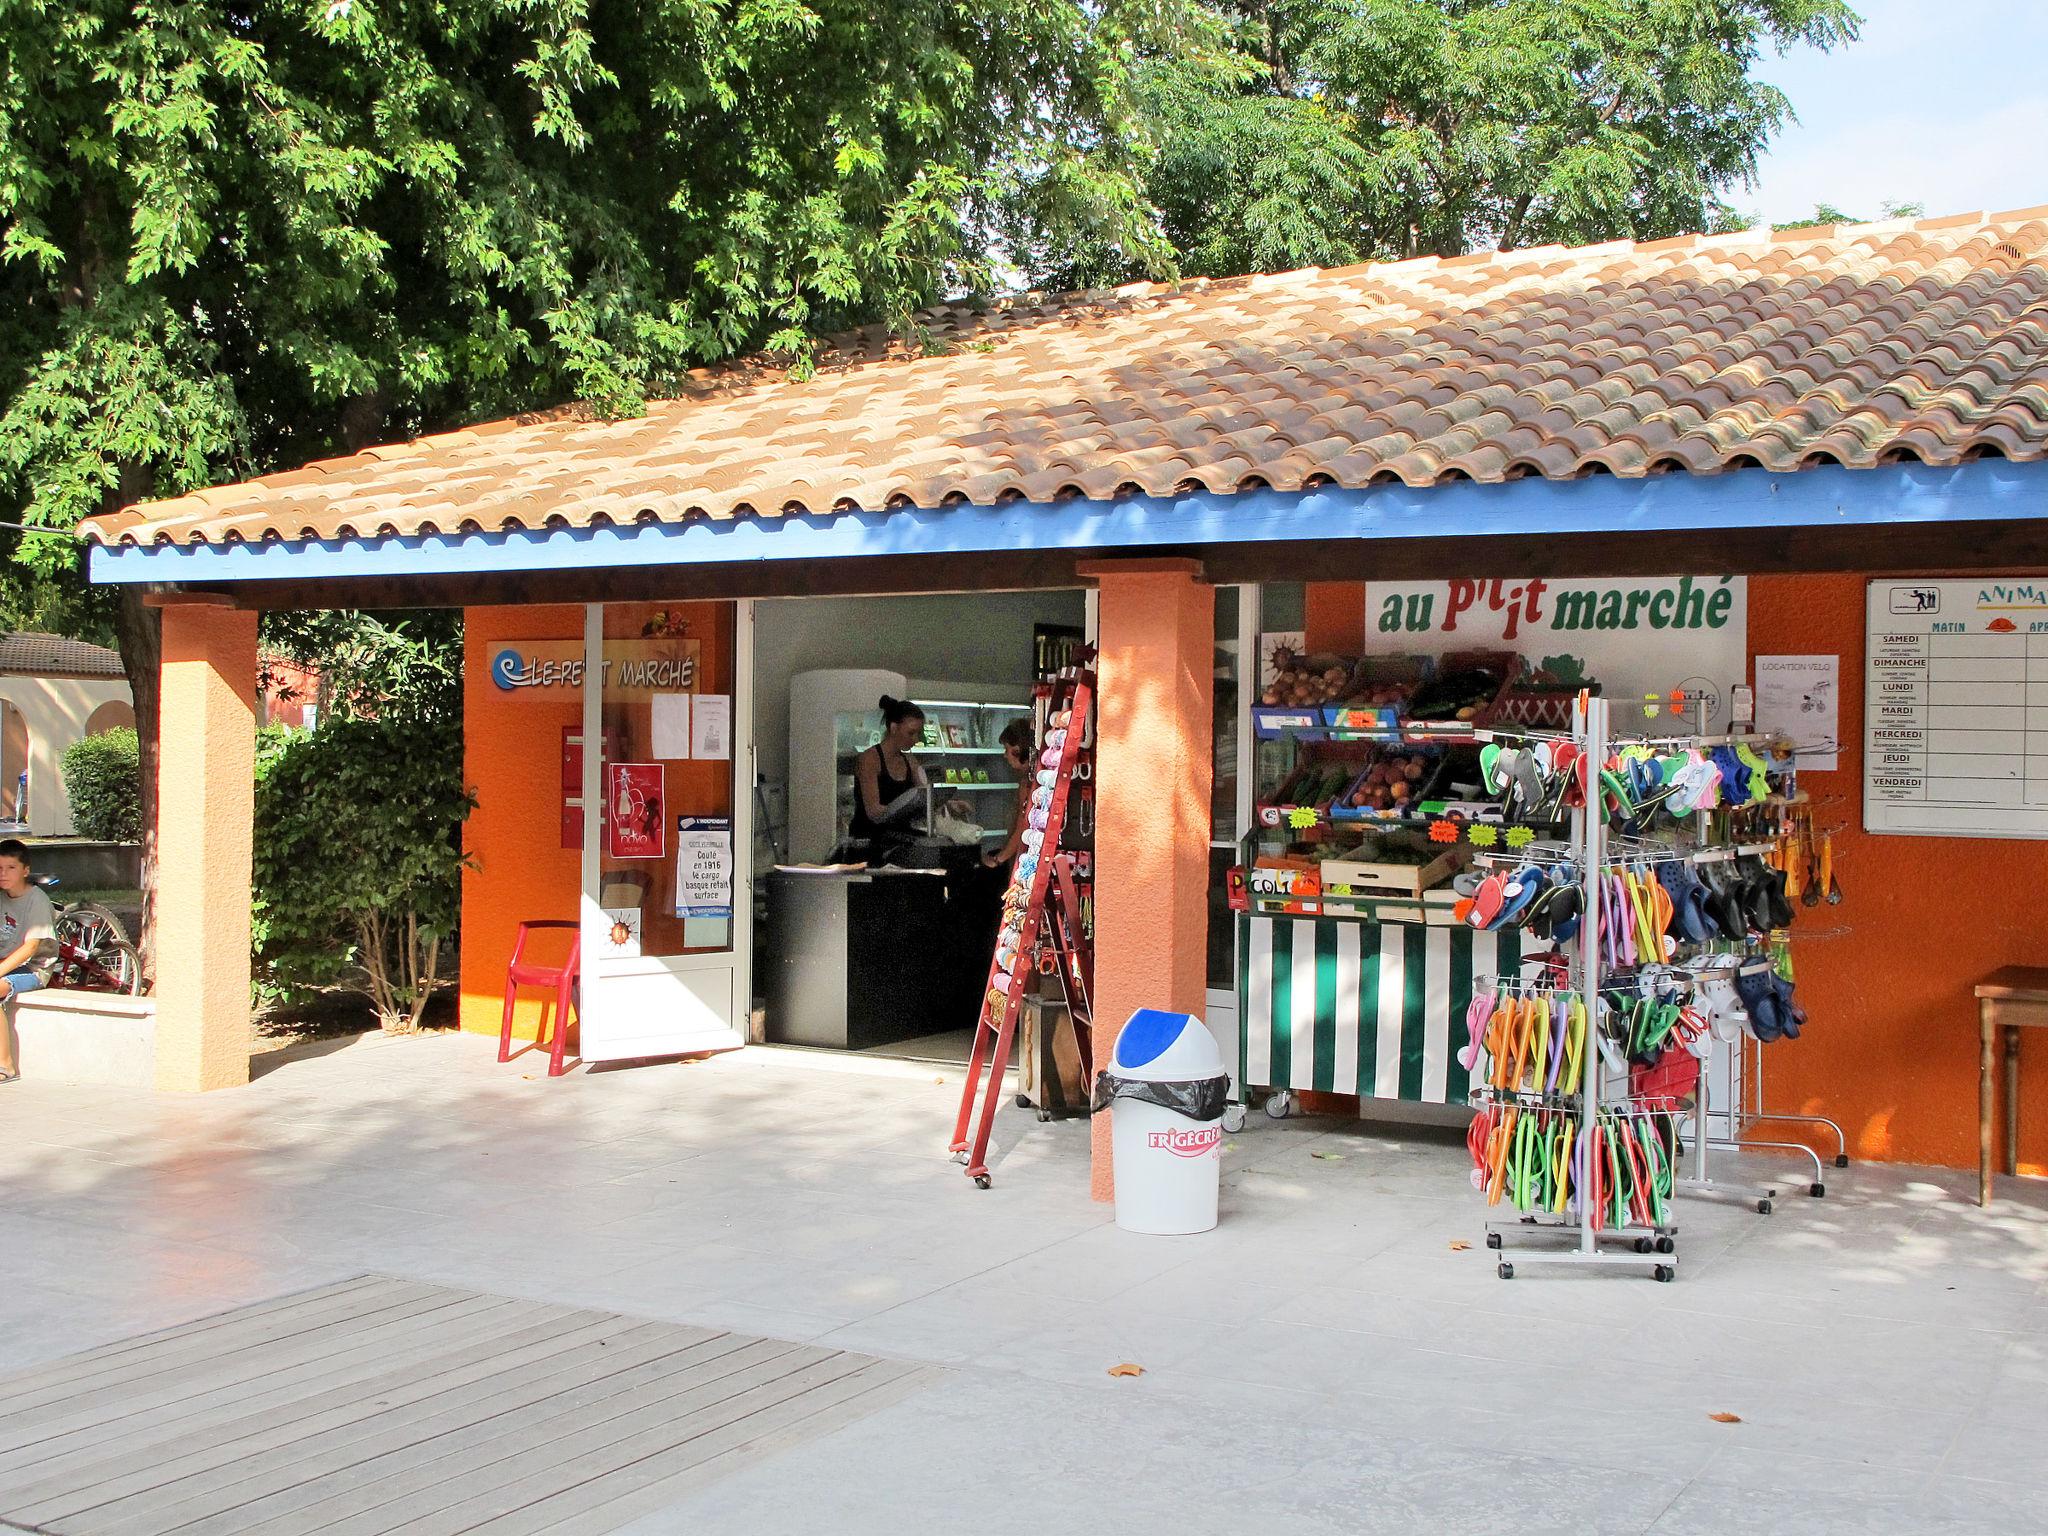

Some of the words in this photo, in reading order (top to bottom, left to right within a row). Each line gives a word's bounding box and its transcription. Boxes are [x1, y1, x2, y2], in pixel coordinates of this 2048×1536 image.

[1977, 585, 2048, 605] ANIMA
[1378, 592, 1434, 632] au
[1550, 573, 1733, 630] marché
[1932, 622, 1966, 632] MATIN
[1883, 635, 1919, 643] SAMEDI
[1762, 663, 1806, 671] LOCATION
[1808, 663, 1831, 671] VELO
[1873, 659, 1926, 667] DIMANCHE
[531, 656, 553, 687] LE
[560, 659, 612, 687] PET
[618, 655, 695, 688] MARCHÉ
[1882, 683, 1913, 691] LUNDI
[1874, 730, 1922, 738] MERCREDI
[1882, 754, 1910, 763] JEUDI
[1873, 778, 1922, 786] VENDREDI
[697, 850, 717, 860] Coulé
[693, 862, 702, 870] en
[704, 861, 721, 870] 1916
[701, 873, 720, 882] cargo
[685, 881, 709, 891] basque
[710, 881, 729, 889] refait
[694, 891, 719, 900] surface
